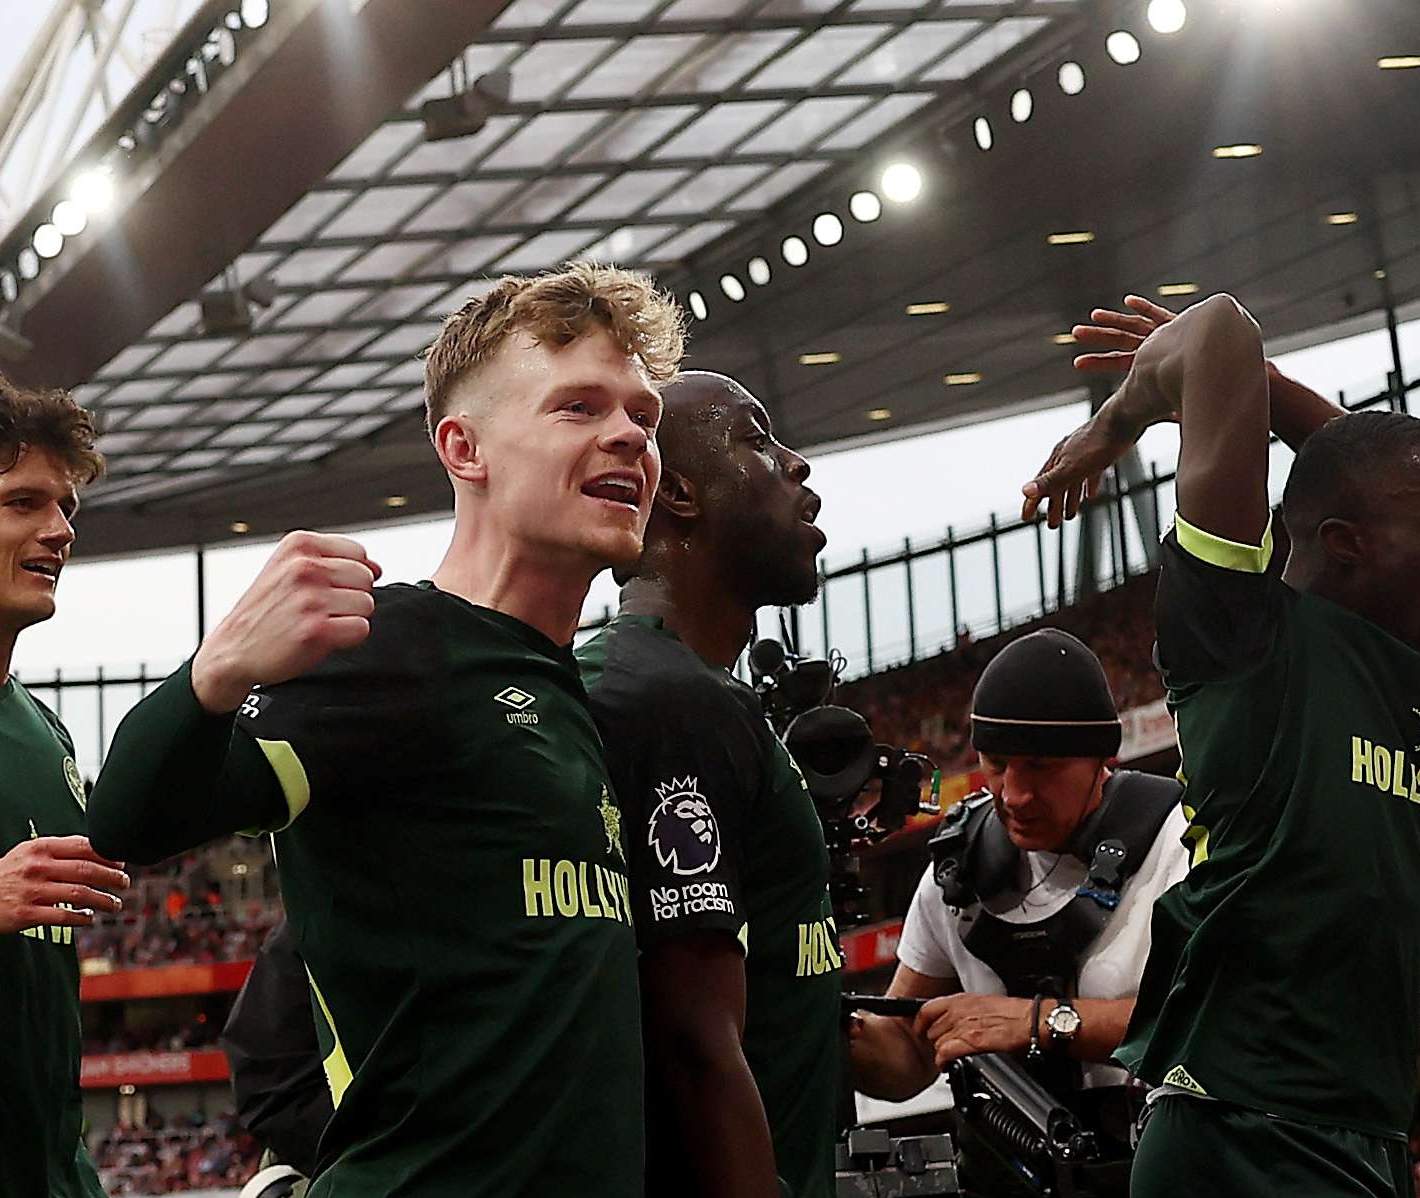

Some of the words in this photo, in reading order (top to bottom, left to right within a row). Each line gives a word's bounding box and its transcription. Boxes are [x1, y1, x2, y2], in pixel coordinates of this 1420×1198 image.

[506, 710, 539, 724] umbro
[650, 886, 679, 907] No
[681, 882, 729, 900] room
[654, 902, 681, 922] for
[684, 896, 735, 915] racism
